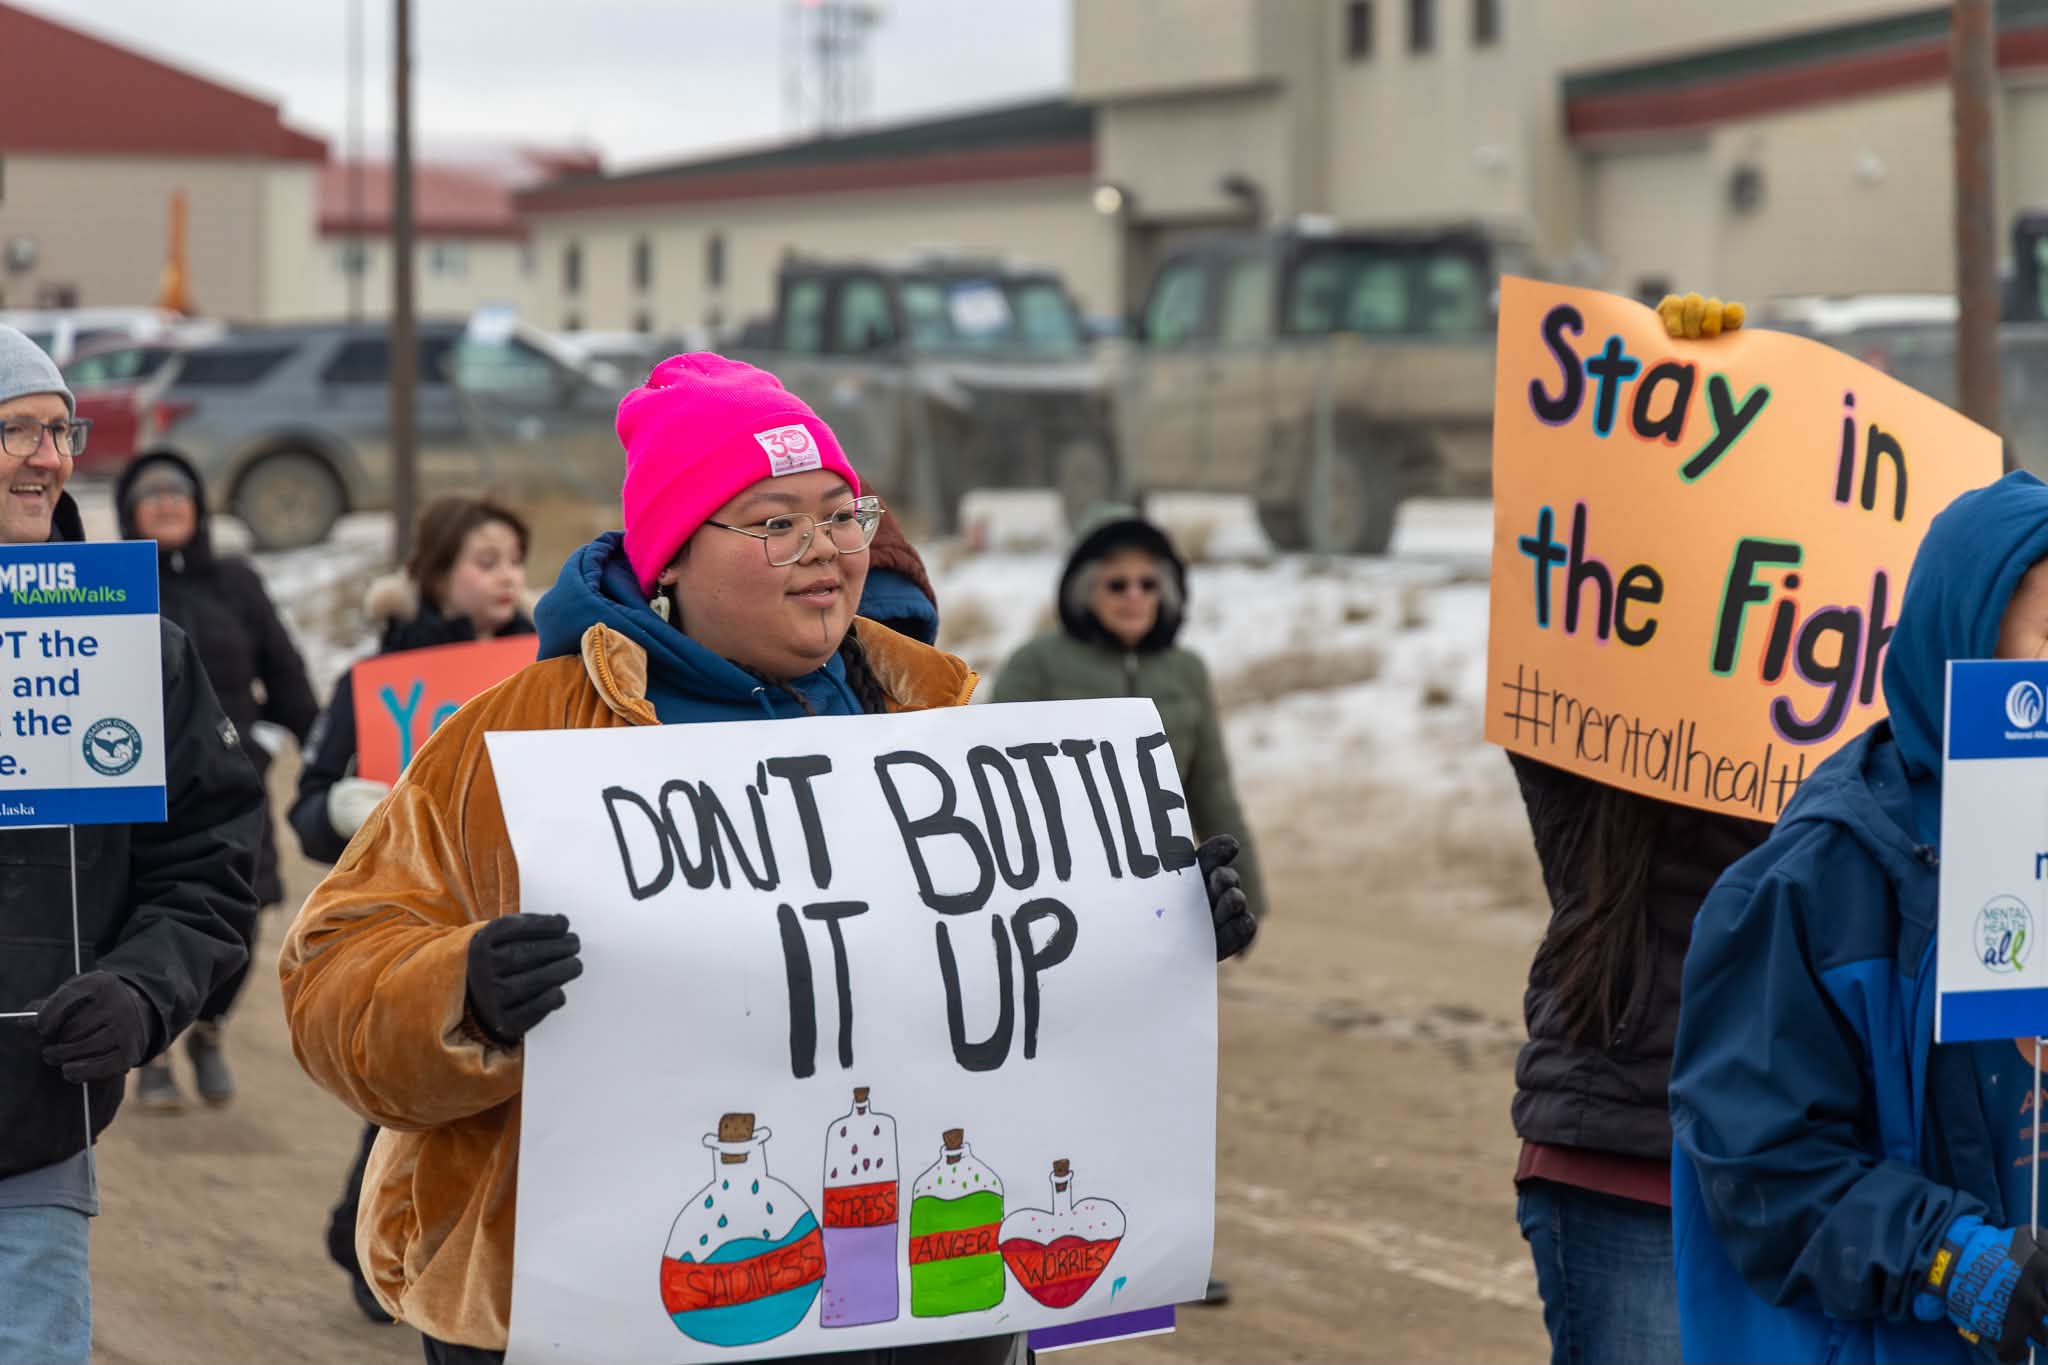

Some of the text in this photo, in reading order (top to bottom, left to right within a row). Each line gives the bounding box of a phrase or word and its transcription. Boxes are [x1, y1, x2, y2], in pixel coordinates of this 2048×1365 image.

[1528, 304, 1908, 522] Stay in
[1518, 500, 1665, 649] the
[13, 586, 127, 605] NAMIWalks
[39, 629, 99, 659] the
[12, 668, 80, 698] and
[12, 708, 73, 737] the
[602, 732, 1198, 915] DON'T BOTTLE
[1984, 929, 2026, 970] all
[776, 897, 1079, 1079] IT UP
[825, 1191, 897, 1226] STRESS
[915, 1229, 992, 1262] ANGER
[685, 1240, 825, 1310] SADNESS
[1018, 1247, 1107, 1286] WORRIES
